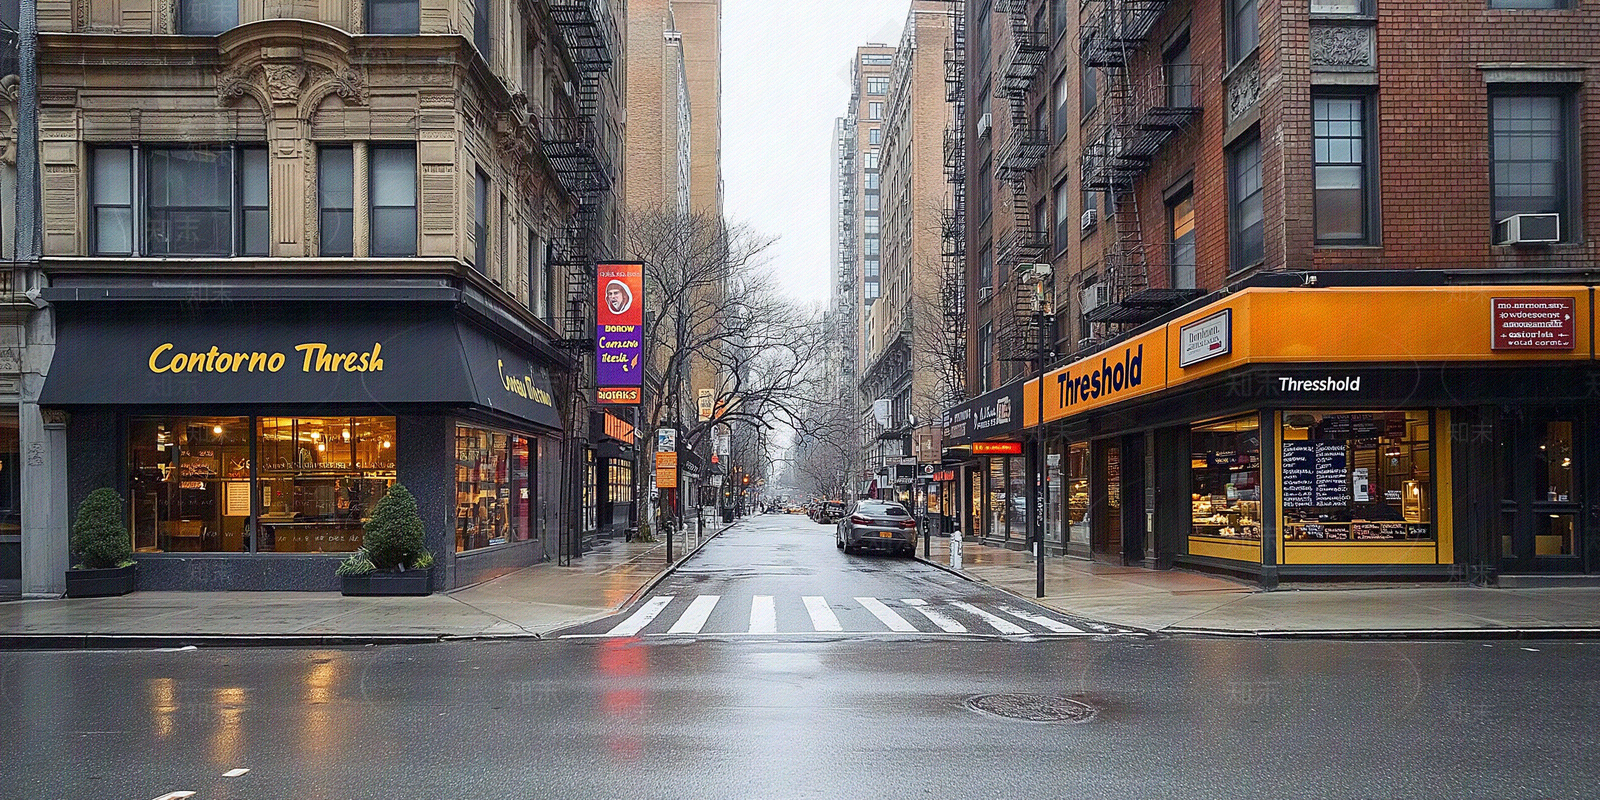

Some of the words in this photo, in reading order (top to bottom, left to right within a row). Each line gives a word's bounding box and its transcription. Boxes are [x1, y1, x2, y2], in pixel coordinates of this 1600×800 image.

[149, 343, 286, 373] Contorno
[294, 343, 384, 372] Thresh
[1058, 344, 1143, 409] Threshold
[1278, 376, 1361, 392] Thresshold
